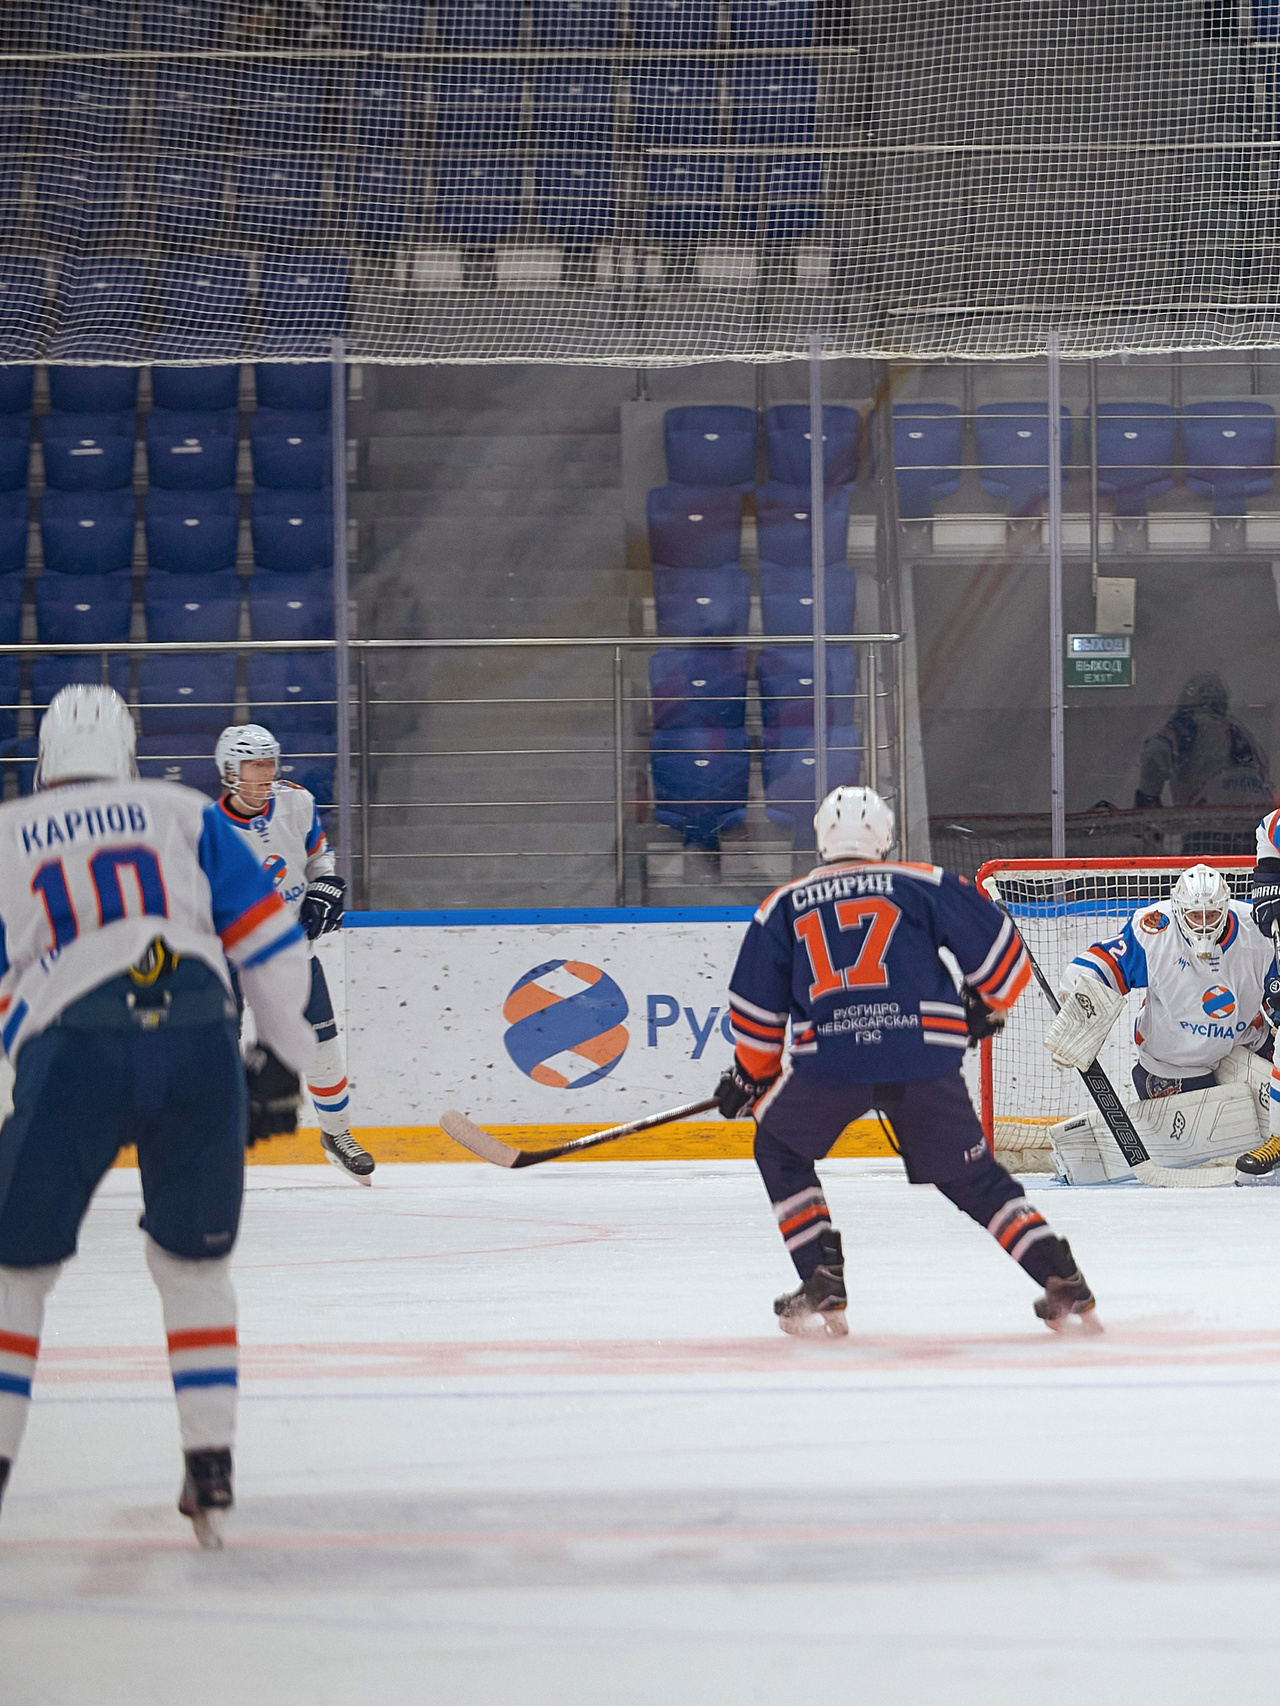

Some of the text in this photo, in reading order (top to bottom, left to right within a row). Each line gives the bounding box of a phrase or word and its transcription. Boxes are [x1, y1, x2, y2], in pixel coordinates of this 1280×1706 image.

[1075, 660, 1122, 672] ВЫХОД
[1083, 673, 1113, 683] EXIT
[22, 803, 147, 853] КАРПОВ
[791, 873, 894, 912] СПИРИН
[793, 896, 901, 1003] 17
[833, 1002, 899, 1021] РУСГИДРО
[817, 1015, 919, 1035] ЧЕБОКСАРСКАЯ
[855, 1030, 883, 1044] ГЭС
[1087, 1075, 1146, 1164] BAUER
